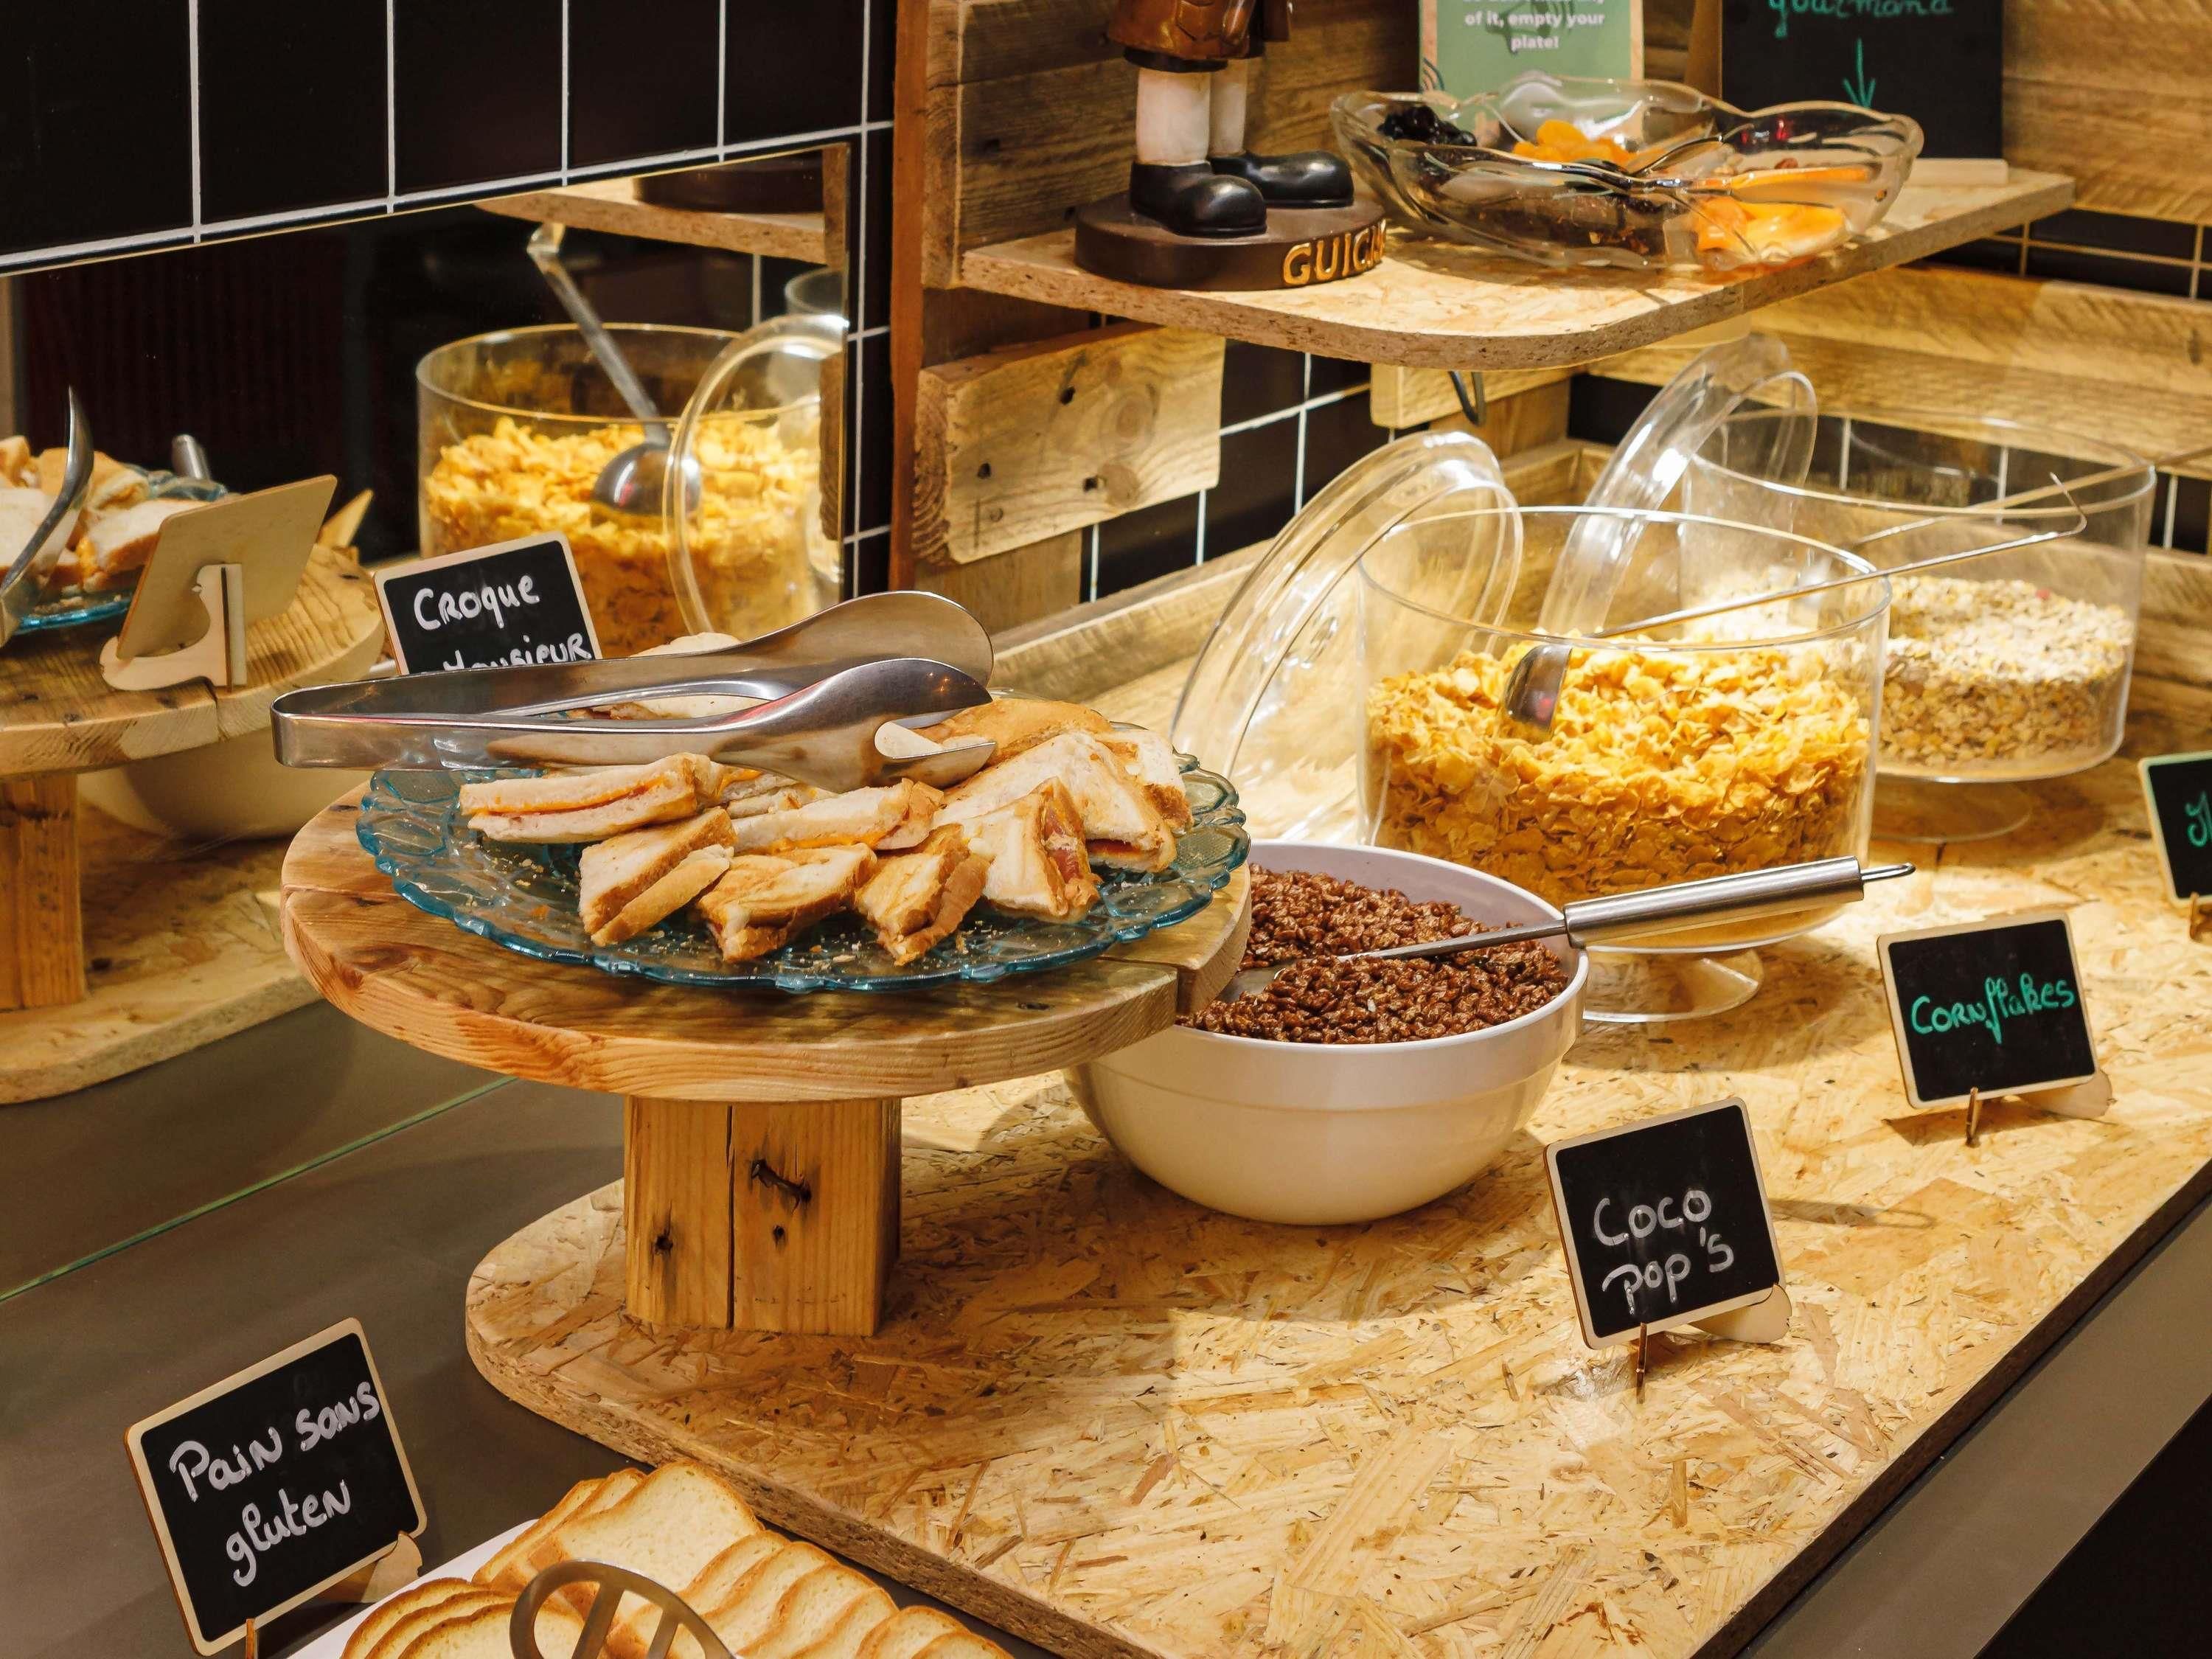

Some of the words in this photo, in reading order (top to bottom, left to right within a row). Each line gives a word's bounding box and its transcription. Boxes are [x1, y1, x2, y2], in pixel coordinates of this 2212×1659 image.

[1464, 10, 1483, 26] of
[1486, 10, 1504, 27] it,
[1508, 12, 1562, 27] empty
[1567, 13, 1604, 27] your
[1511, 35, 1559, 52] plate!
[1593, 1189, 1712, 1247] Coco
